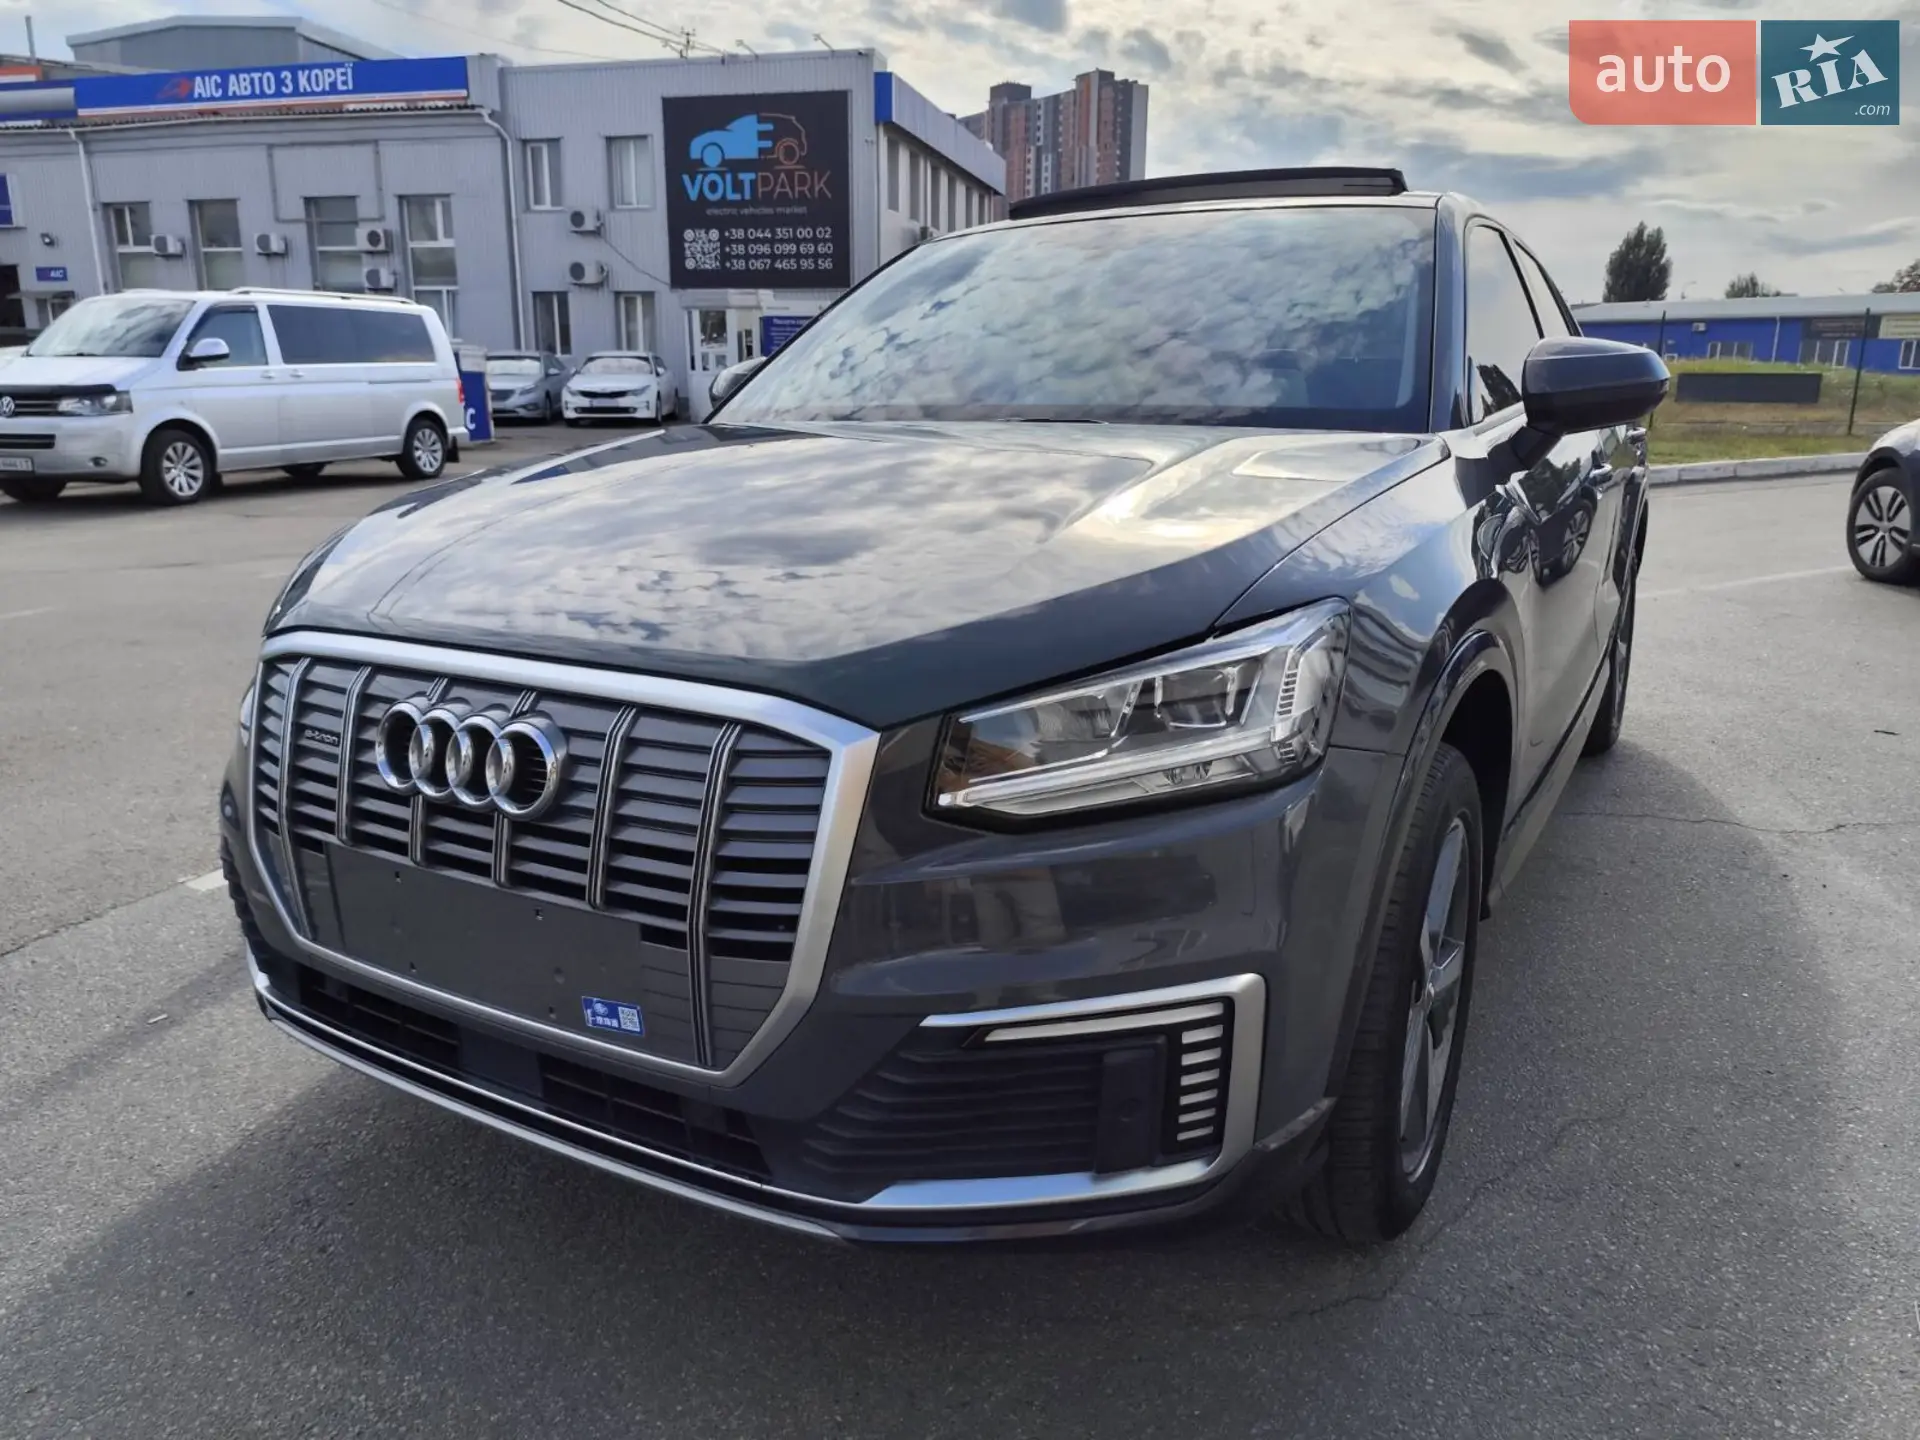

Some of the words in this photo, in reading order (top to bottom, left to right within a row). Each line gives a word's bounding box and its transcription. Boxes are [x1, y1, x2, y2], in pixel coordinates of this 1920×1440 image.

[228, 71, 276, 96] АВТО
[280, 70, 294, 94] З
[297, 63, 354, 92] КОРЕЇ
[724, 228, 745, 239] +38
[747, 228, 772, 239] 044
[774, 228, 794, 239] 351
[796, 227, 813, 239] 00
[816, 227, 832, 239] 02
[725, 243, 746, 255] +38
[747, 243, 772, 255] 096
[773, 243, 797, 255] 099
[799, 243, 815, 254] 69
[817, 242, 834, 254] 60
[725, 259, 746, 270] +38
[748, 259, 771, 270] 067
[774, 259, 797, 270] 465
[799, 258, 815, 270] 95
[817, 258, 833, 270] 56
